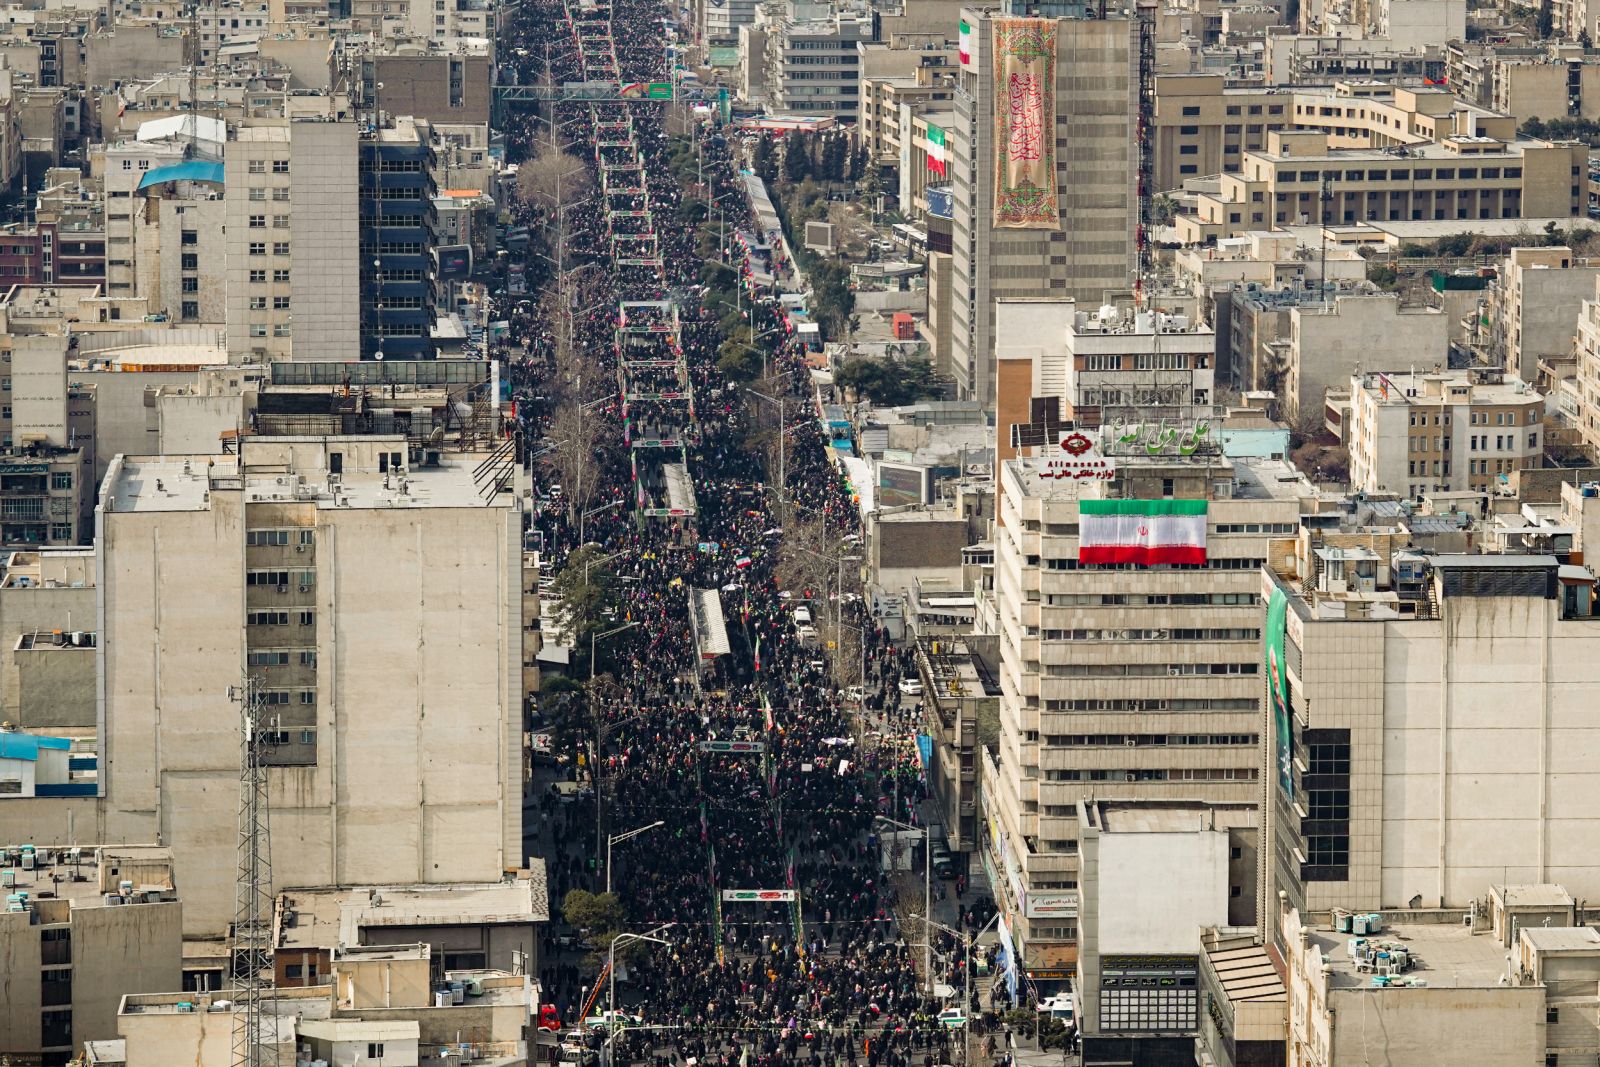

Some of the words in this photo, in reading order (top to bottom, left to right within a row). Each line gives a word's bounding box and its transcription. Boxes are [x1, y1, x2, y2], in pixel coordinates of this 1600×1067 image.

[1146, 417, 1176, 455] ولی
[1179, 416, 1209, 455] علی
[1039, 470, 1054, 480] نسب
[1055, 469, 1072, 480] عالی
[1073, 469, 1095, 480] خانگی
[1096, 469, 1115, 480] لوازم
